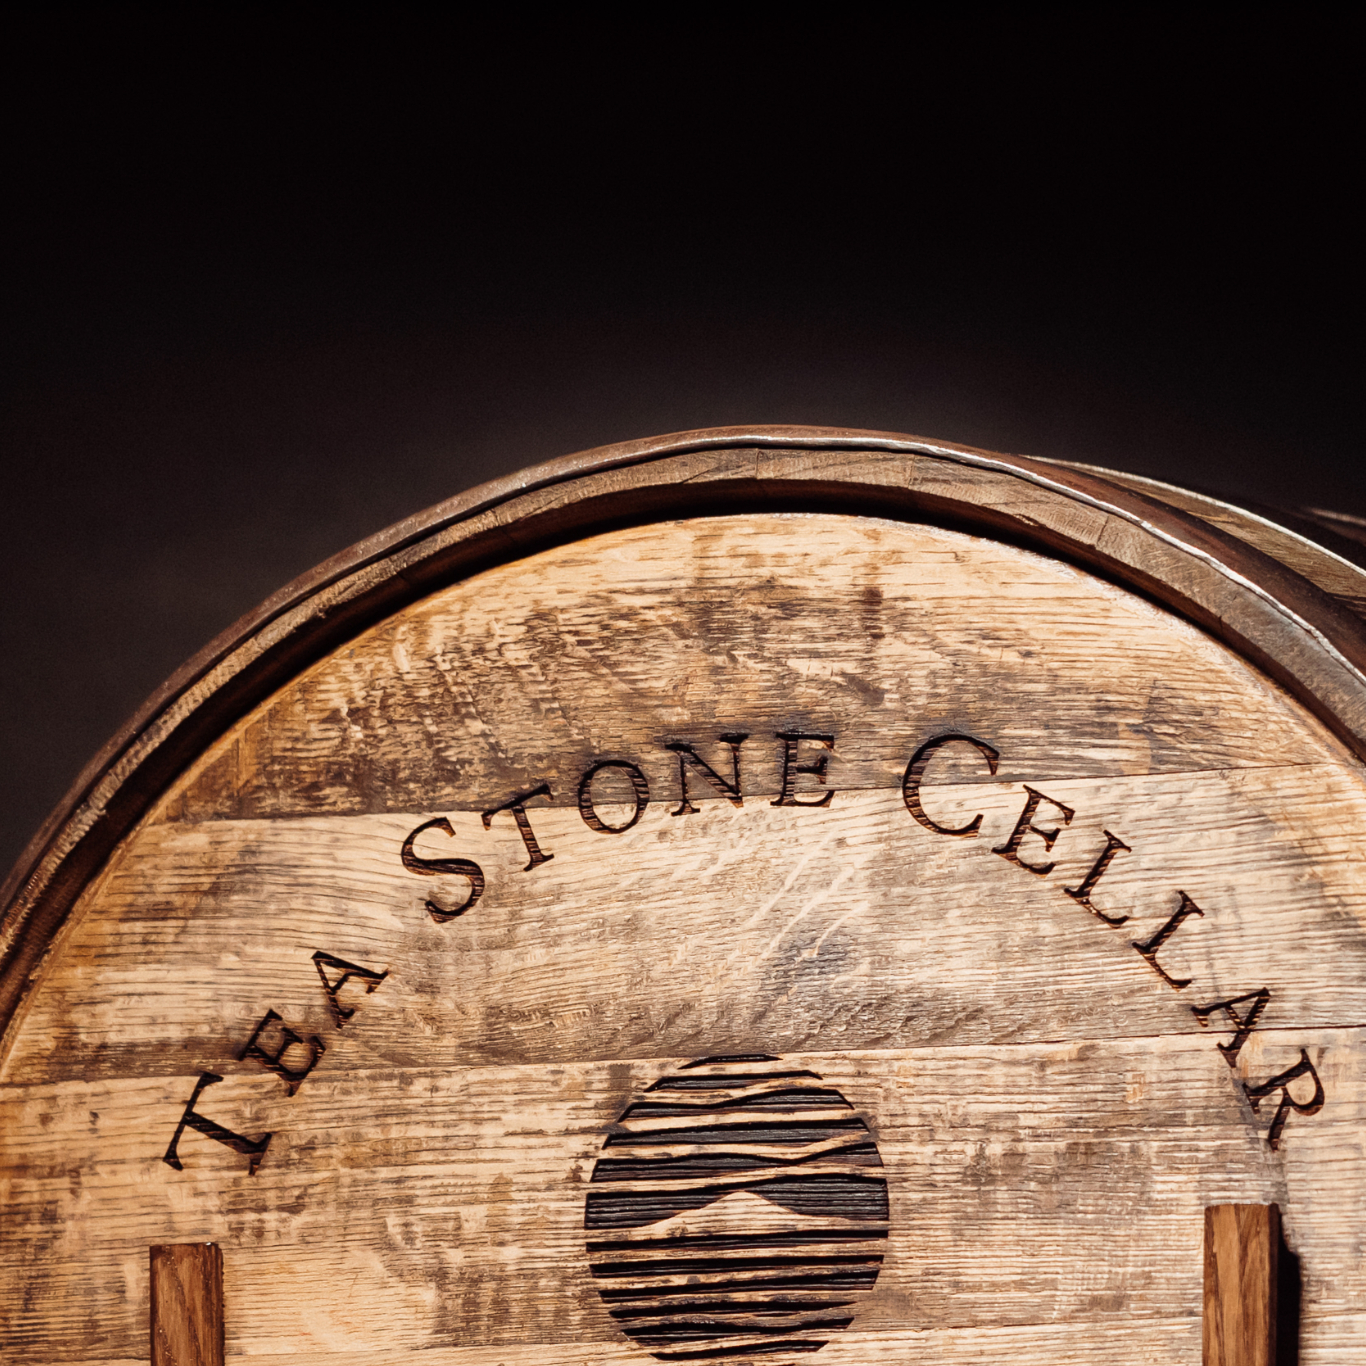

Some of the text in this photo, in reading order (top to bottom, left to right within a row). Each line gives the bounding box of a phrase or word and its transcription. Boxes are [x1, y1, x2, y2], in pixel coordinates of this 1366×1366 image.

[161, 731, 1326, 1177] TEA STONE CELLAR
